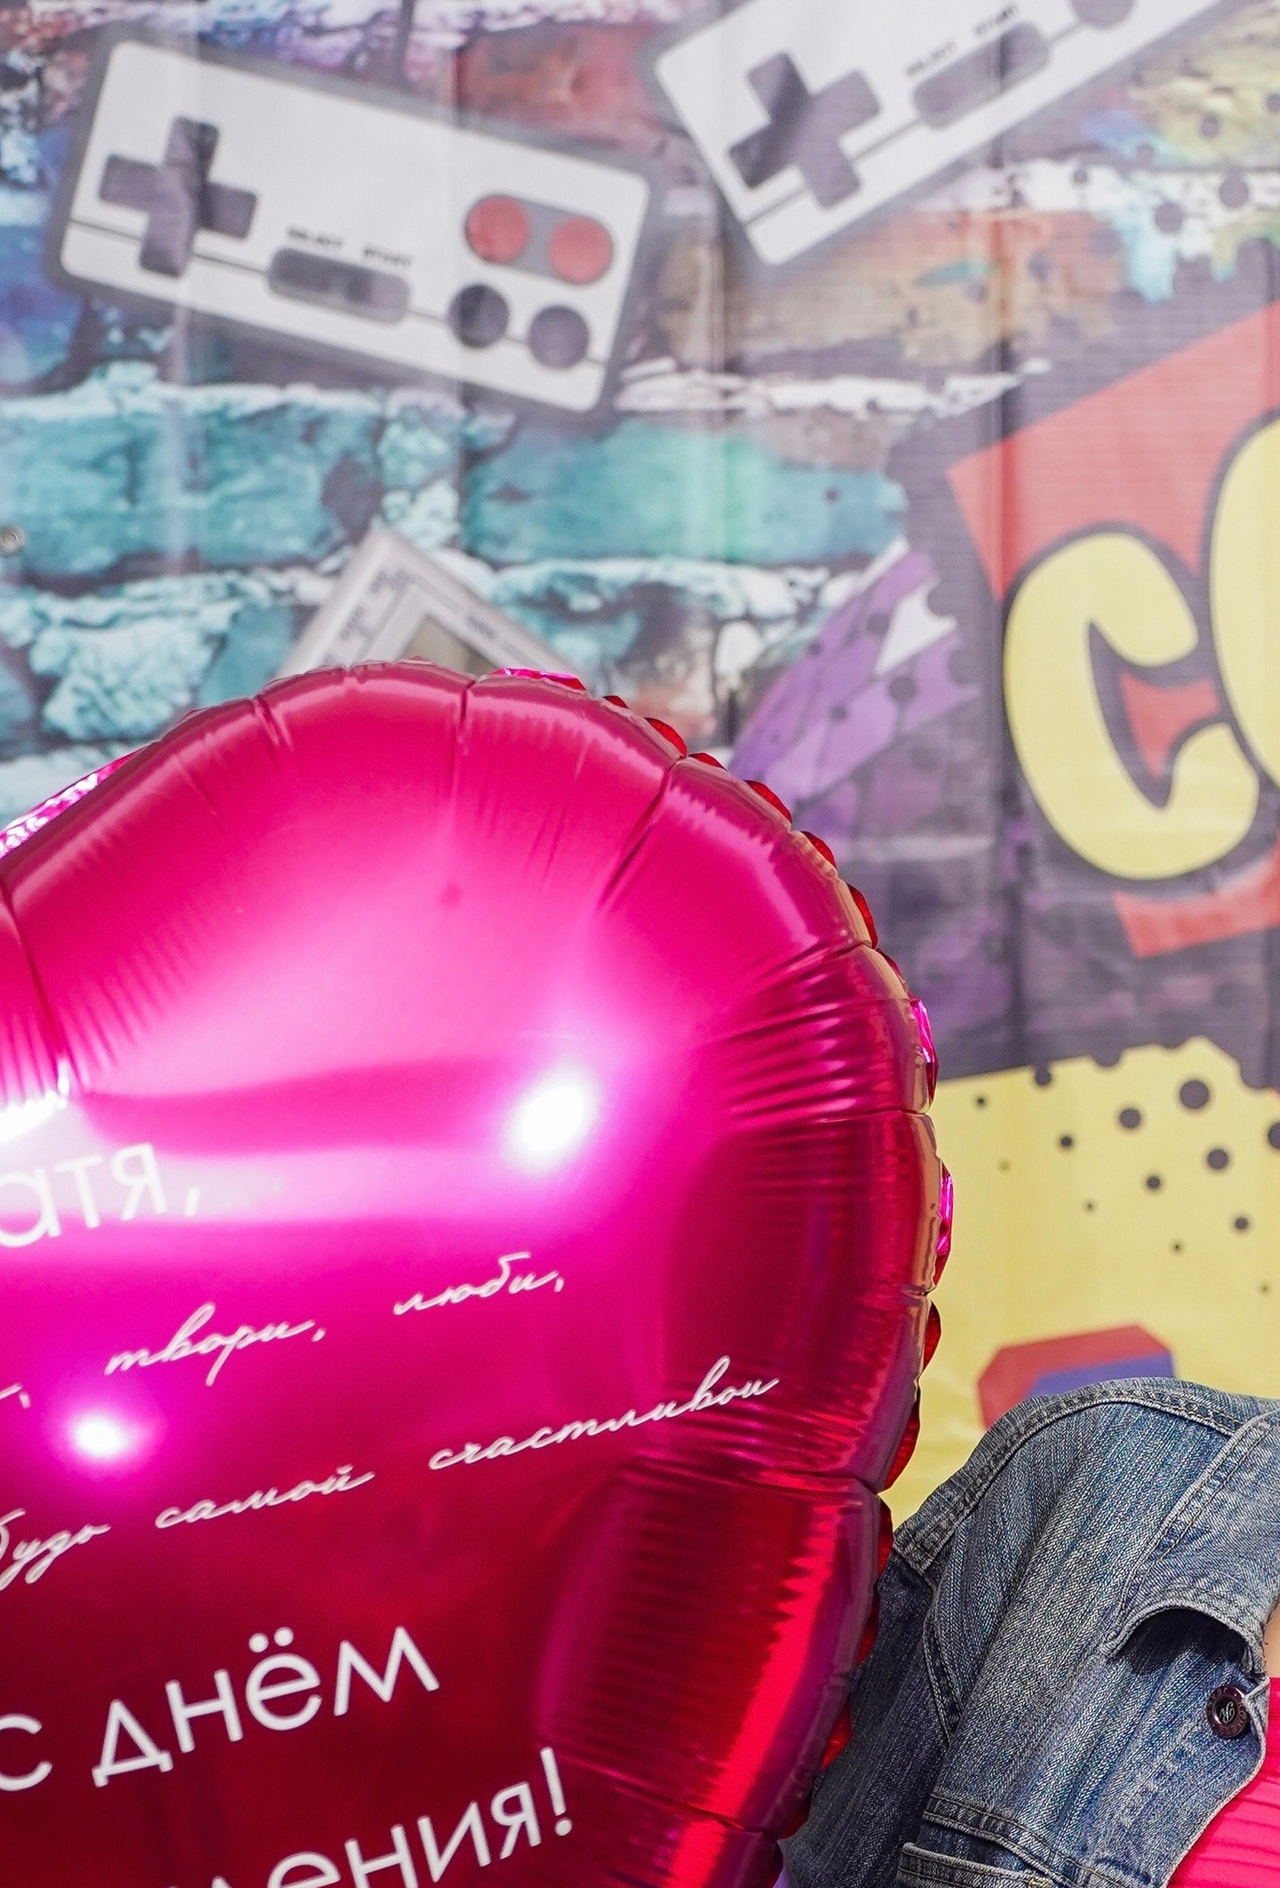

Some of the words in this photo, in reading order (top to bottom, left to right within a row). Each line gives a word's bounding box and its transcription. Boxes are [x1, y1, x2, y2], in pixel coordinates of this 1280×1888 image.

[0, 1141, 200, 1248] атя,
[104, 1301, 326, 1387] твори,
[393, 1251, 564, 1316] люби,
[155, 1464, 375, 1529] самой
